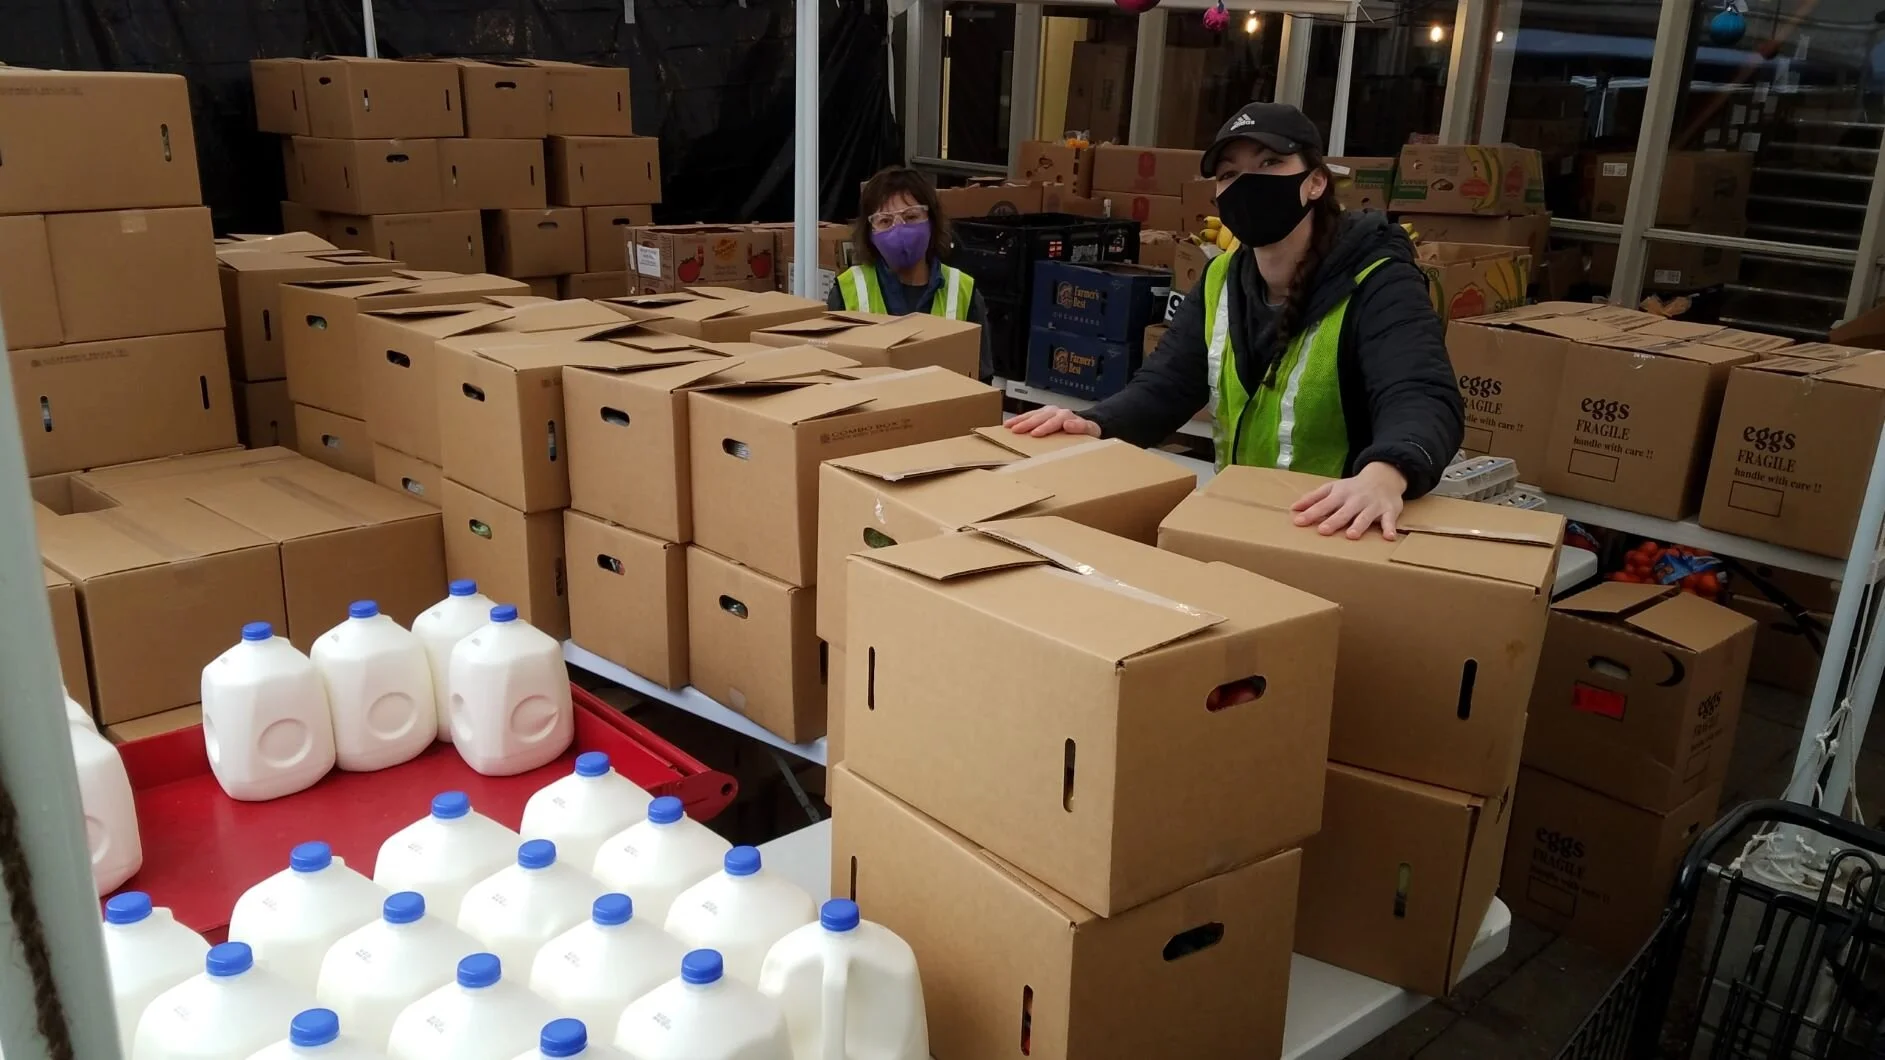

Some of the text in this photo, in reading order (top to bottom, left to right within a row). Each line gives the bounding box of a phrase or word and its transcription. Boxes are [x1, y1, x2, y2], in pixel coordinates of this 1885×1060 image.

[1073, 296, 1086, 310] Best
[1074, 285, 1099, 301] Farmer's
[1068, 362, 1081, 375] Best
[1070, 351, 1095, 367] Farmer's
[1459, 375, 1502, 398] eggs
[1463, 397, 1503, 415] RAGILE
[1581, 396, 1631, 423] eggs
[1479, 416, 1496, 427] with
[1498, 422, 1516, 431] care
[1576, 419, 1631, 441] FRAGILE
[1573, 435, 1602, 450] handle
[1603, 441, 1623, 454] with
[1624, 447, 1645, 458] care
[1743, 425, 1796, 453] eggs
[1737, 449, 1797, 473] FRAGILE
[1734, 467, 1765, 483] handle
[1767, 473, 1788, 487] with
[1790, 481, 1811, 491] care
[1535, 827, 1586, 859] eggs
